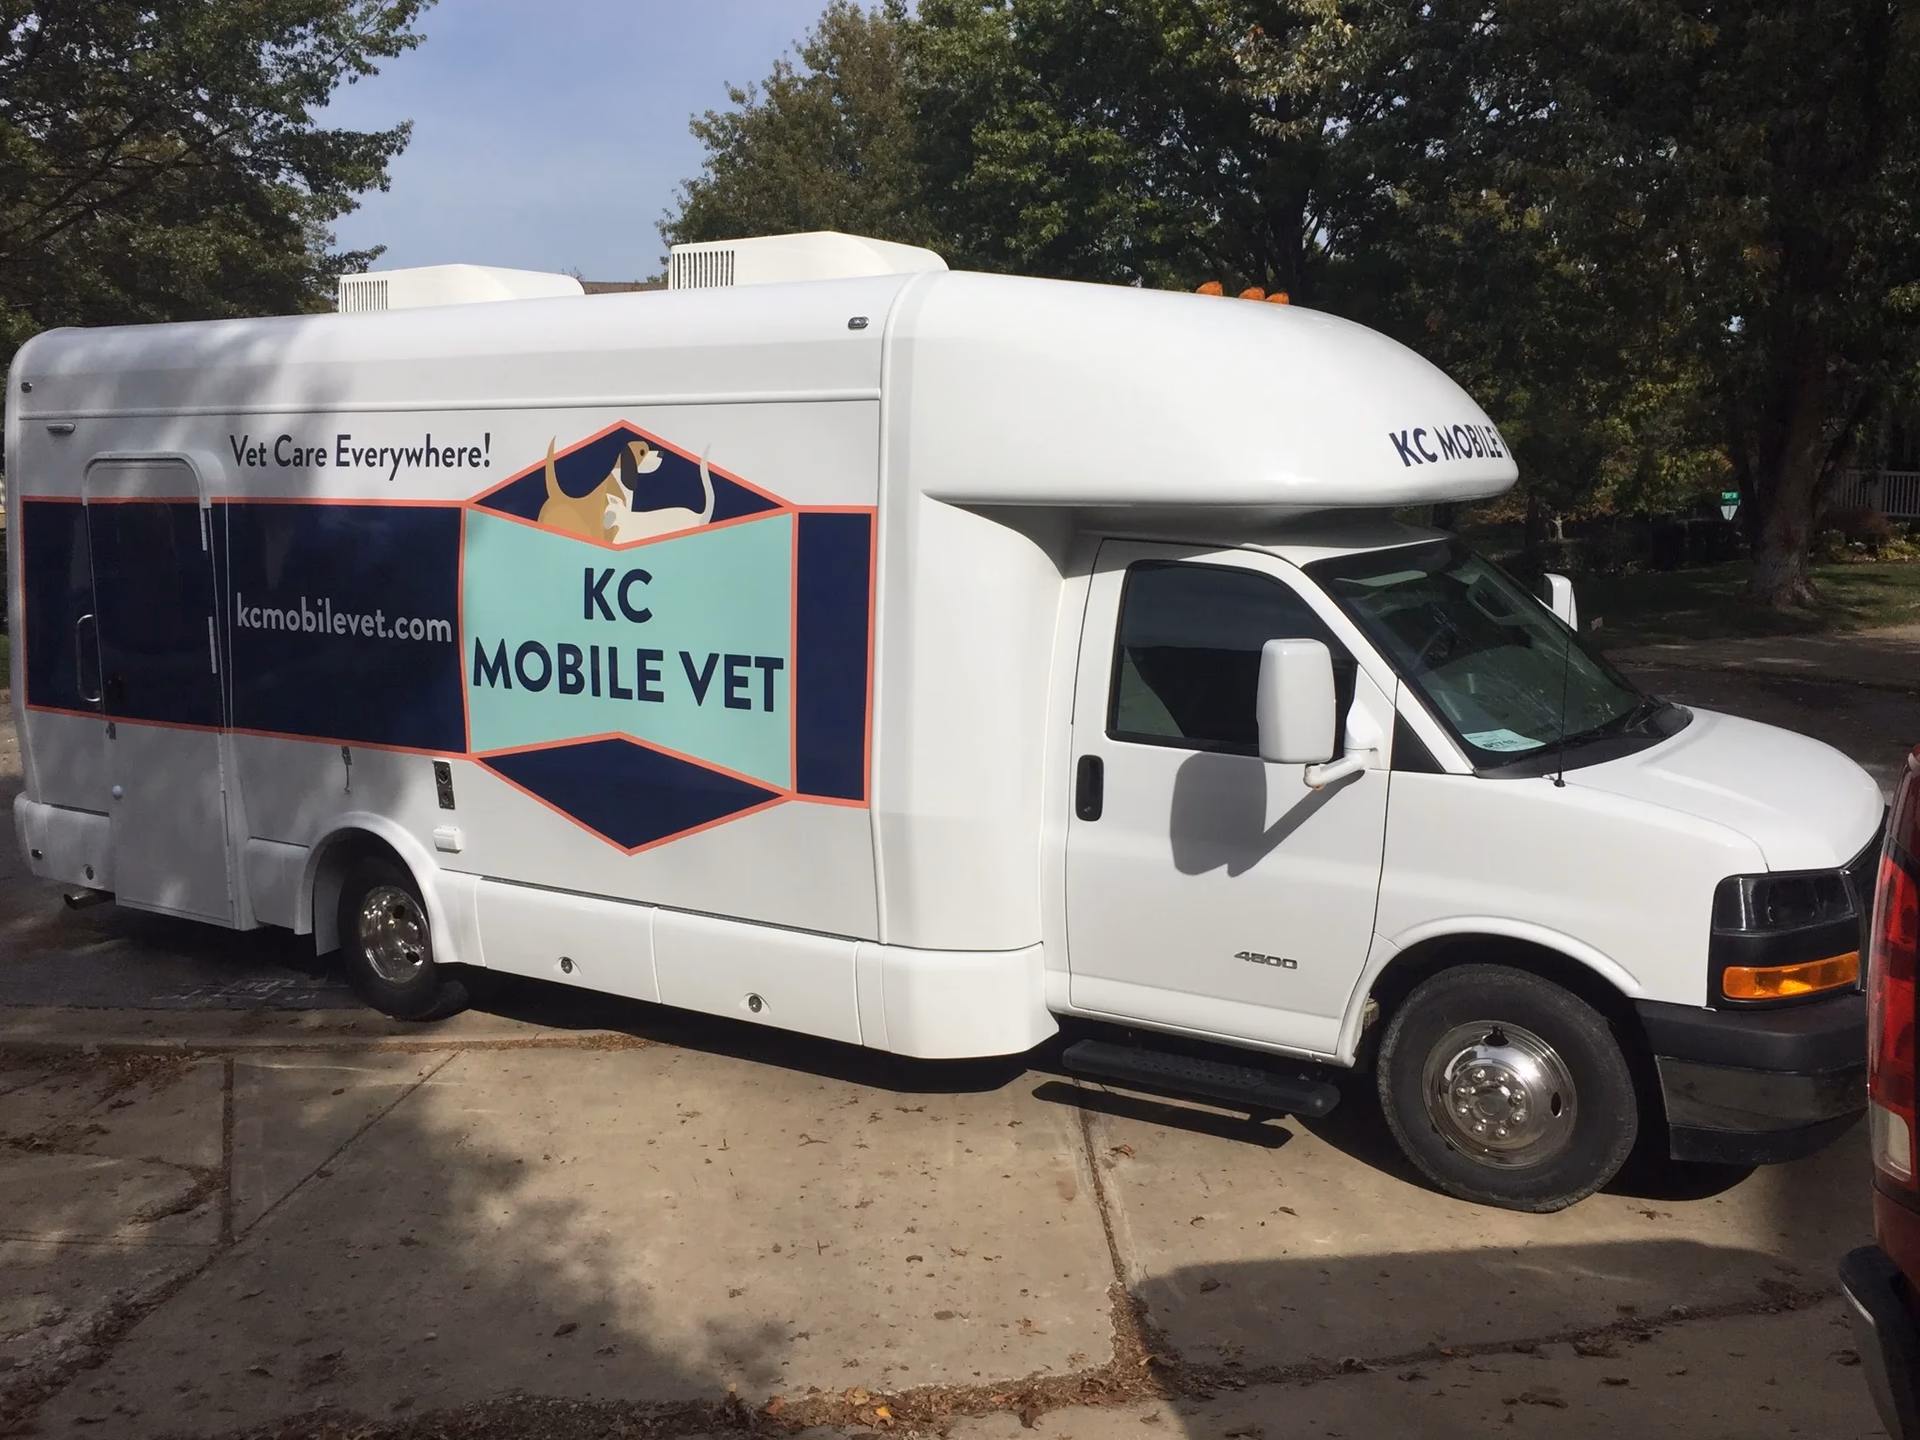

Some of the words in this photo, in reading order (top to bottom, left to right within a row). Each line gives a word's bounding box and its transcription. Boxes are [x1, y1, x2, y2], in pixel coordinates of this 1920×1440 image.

[229, 434, 267, 467] Vet
[274, 434, 327, 468] Care
[336, 432, 491, 481] Everywhere!
[1388, 427, 1438, 467] KC
[1432, 424, 1503, 461] MOBILE
[236, 592, 452, 643] kcmobilevet.com
[583, 567, 653, 623] KC
[472, 636, 665, 703] MOBILE
[679, 650, 785, 713] VET
[1234, 951, 1298, 970] 4500
